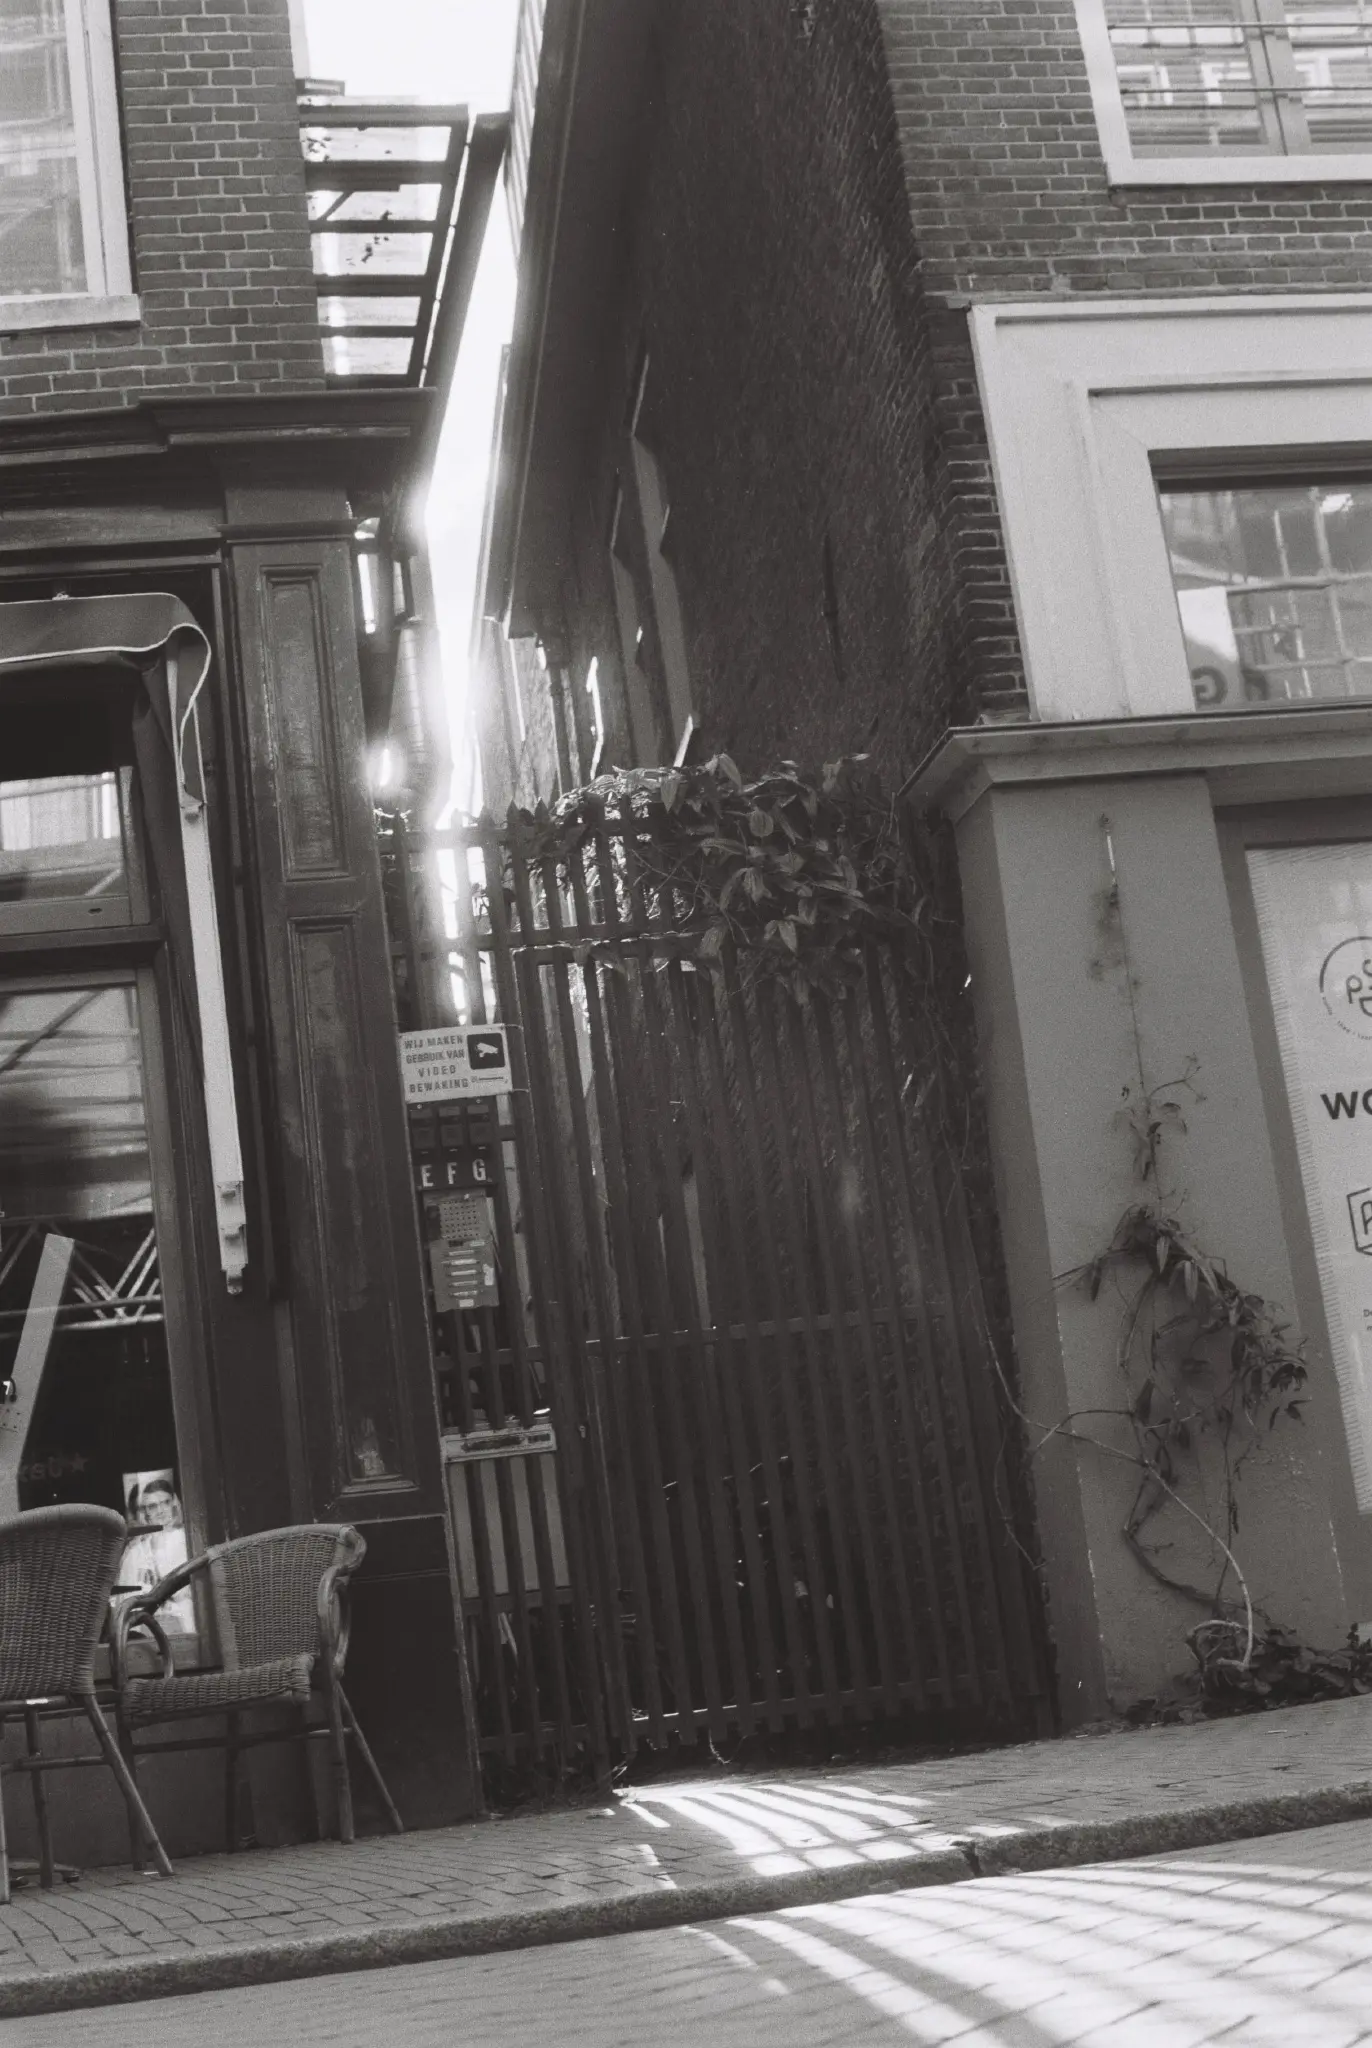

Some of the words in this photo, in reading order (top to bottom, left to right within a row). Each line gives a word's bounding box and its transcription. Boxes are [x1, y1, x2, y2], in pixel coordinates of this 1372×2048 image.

[404, 1039, 423, 1049] WIJ
[427, 1036, 463, 1047] MAKEN
[446, 1049, 465, 1060] VAN
[418, 1065, 456, 1077] VIDEO
[409, 1078, 469, 1093] BEWAKING
[420, 1164, 434, 1187] E
[447, 1162, 457, 1185] F
[472, 1158, 486, 1181] G
